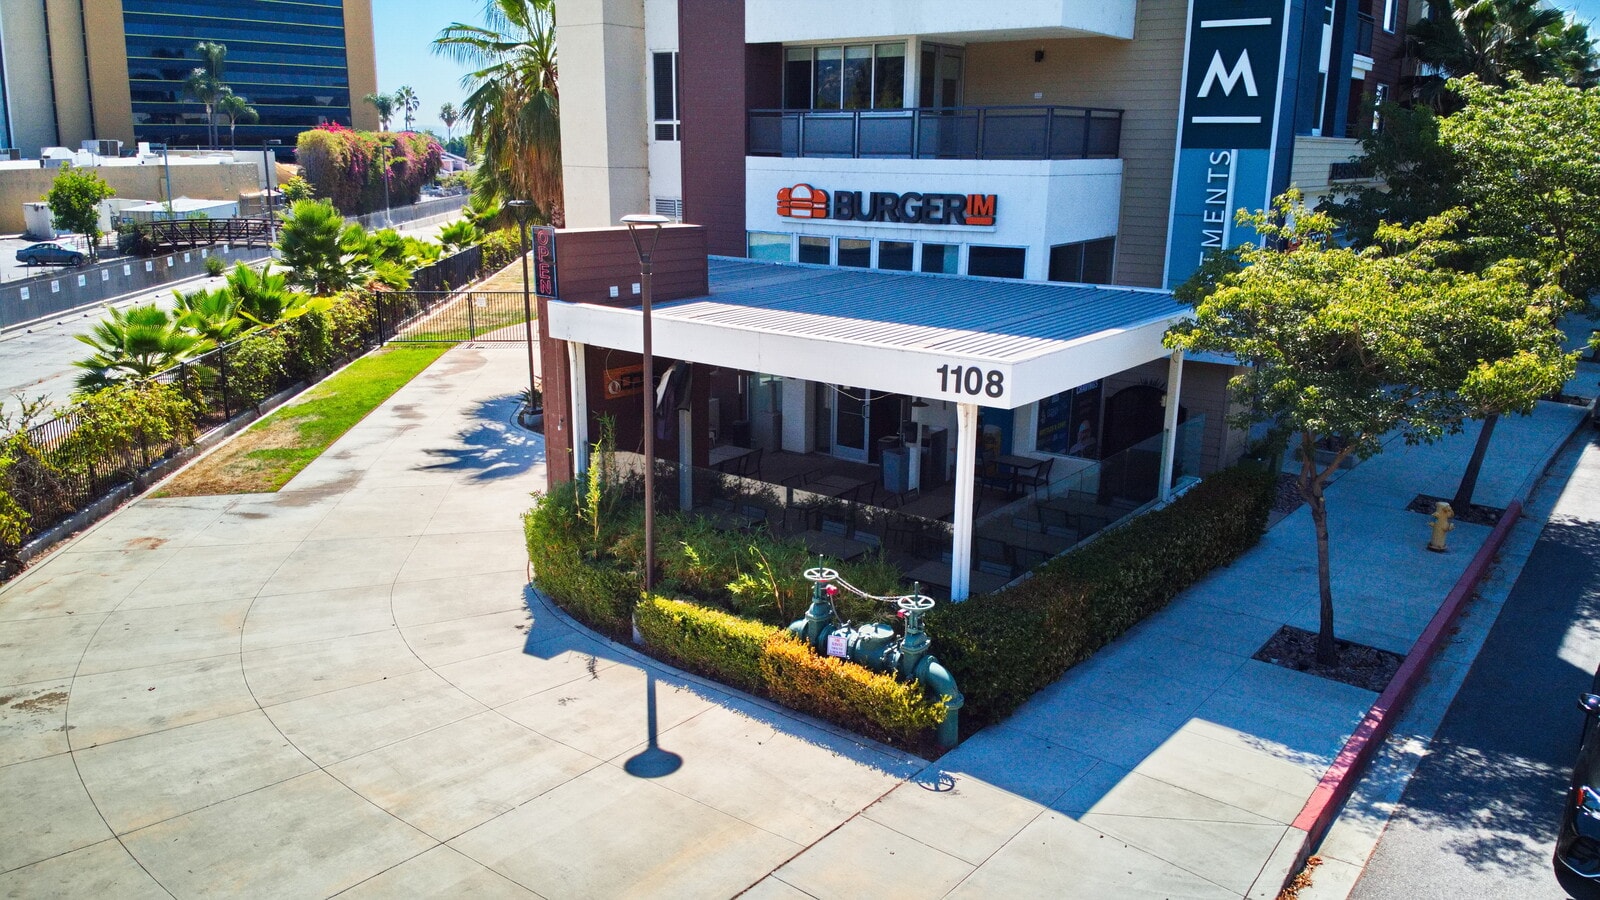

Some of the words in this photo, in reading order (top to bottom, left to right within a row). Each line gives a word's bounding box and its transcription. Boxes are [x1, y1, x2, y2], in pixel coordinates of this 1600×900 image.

[1196, 48, 1259, 97] M
[833, 191, 997, 226] BURGERIM
[537, 230, 552, 295] OPEN
[936, 364, 1004, 398] 1108
